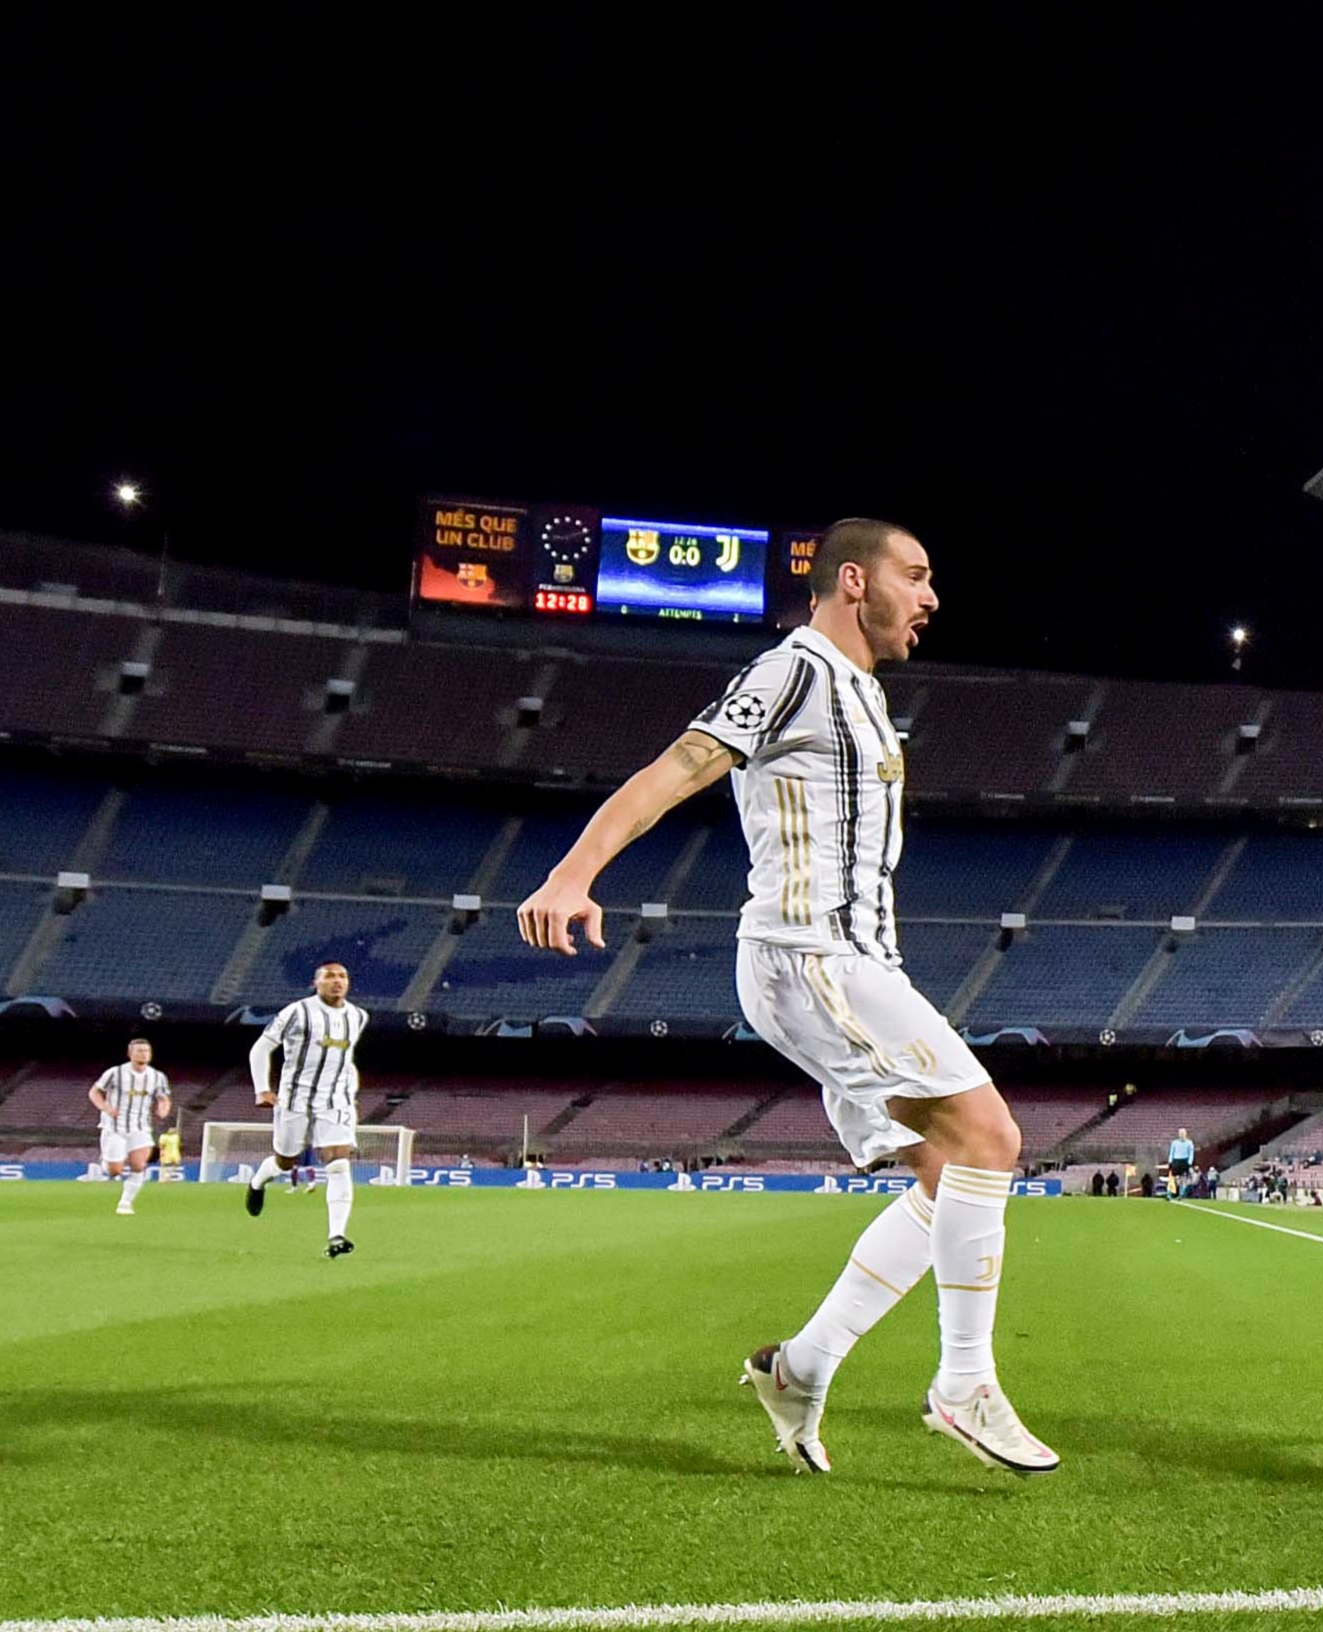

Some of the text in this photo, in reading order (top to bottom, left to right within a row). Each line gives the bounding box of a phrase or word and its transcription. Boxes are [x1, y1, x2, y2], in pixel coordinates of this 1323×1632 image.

[435, 508, 517, 533] MÉS QUE
[436, 529, 515, 551] UN CLUB
[535, 592, 588, 612] 12:28
[336, 1109, 351, 1126] 12
[407, 1169, 475, 1186] PS5
[551, 1172, 616, 1189] PS5
[702, 1176, 764, 1191] PS5
